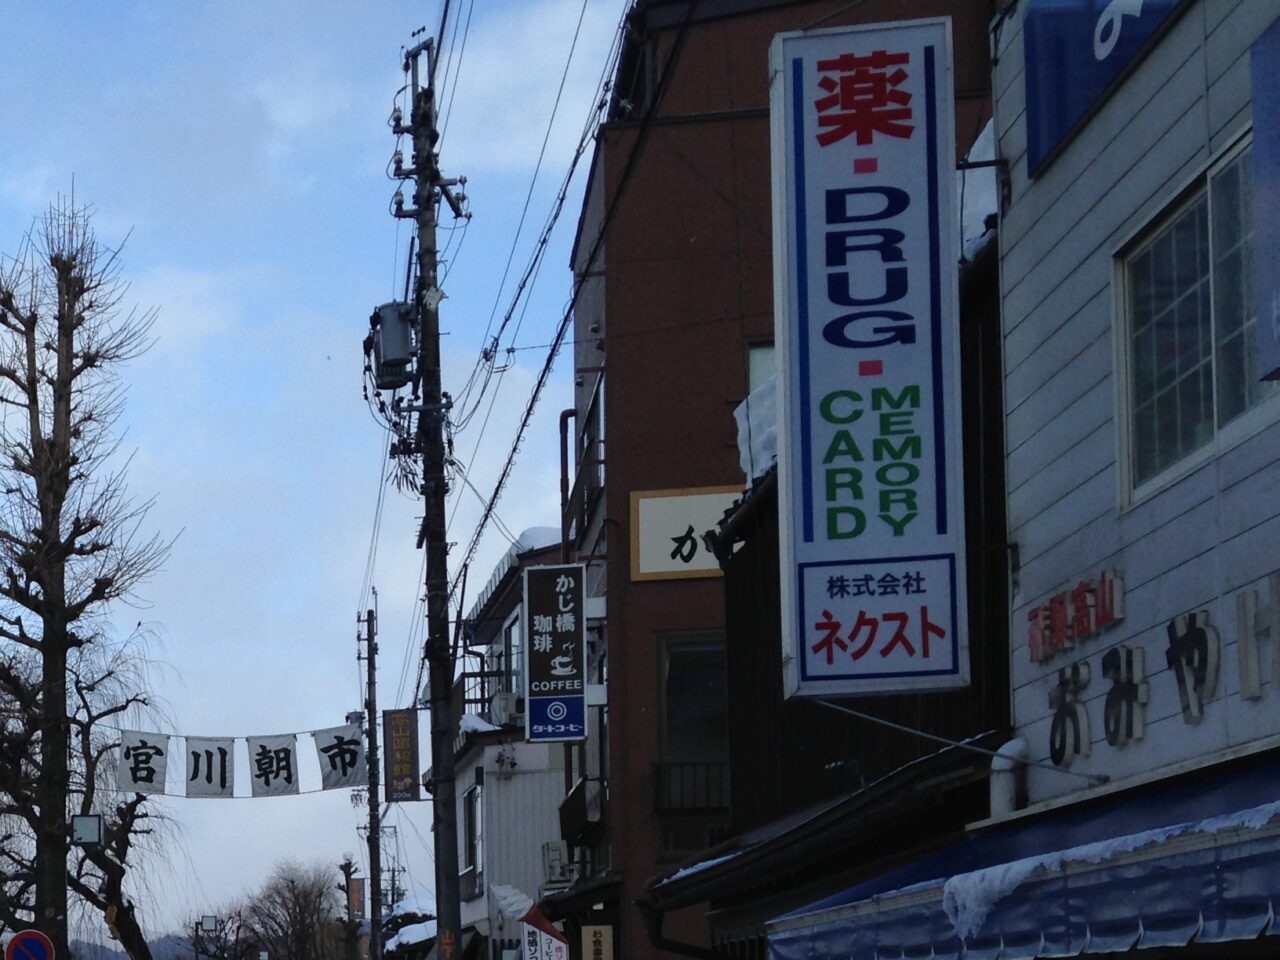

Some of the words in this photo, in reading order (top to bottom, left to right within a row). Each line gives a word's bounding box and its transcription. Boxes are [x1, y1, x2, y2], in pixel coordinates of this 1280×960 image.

[814, 50, 915, 147] 薬
[821, 184, 917, 349] DRUG
[819, 389, 867, 541] CARD
[870, 384, 923, 538] MEMORY
[555, 574, 576, 633] かじ橋
[826, 571, 927, 598] 株式会社
[533, 613, 553, 653] 珈琲
[811, 605, 946, 666] ネクスト
[531, 680, 582, 691] COFFEE
[124, 736, 360, 789] 宮川朝市
